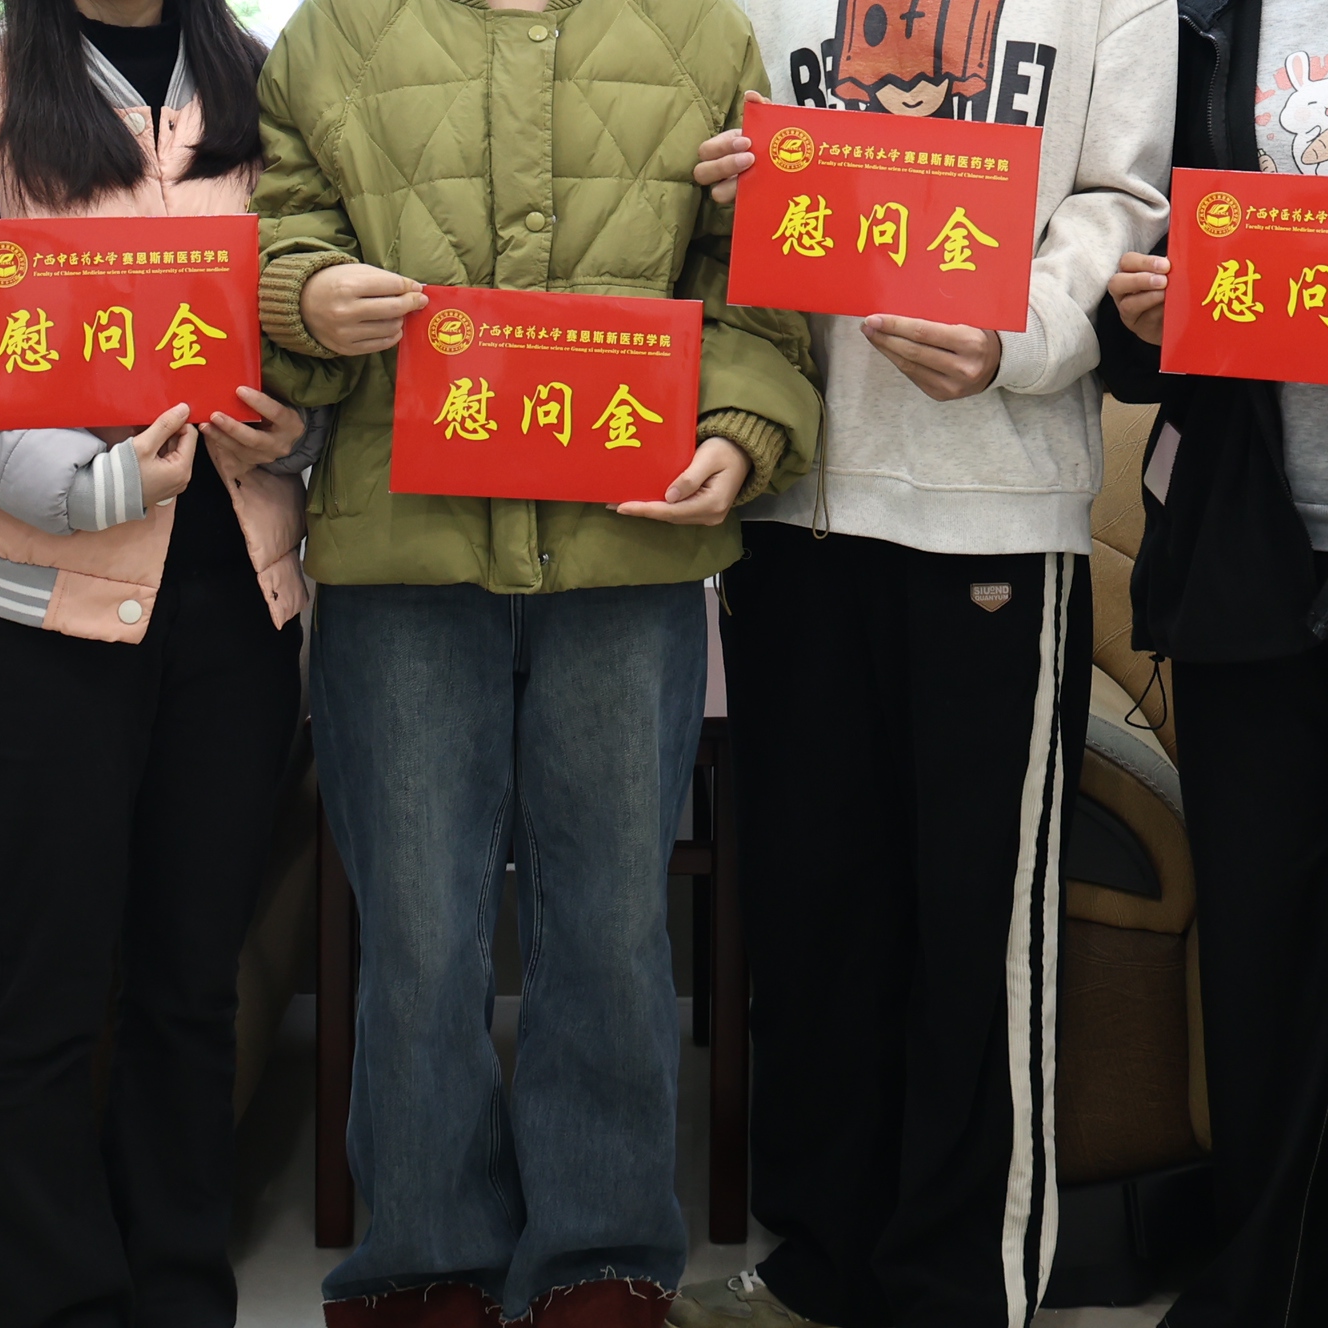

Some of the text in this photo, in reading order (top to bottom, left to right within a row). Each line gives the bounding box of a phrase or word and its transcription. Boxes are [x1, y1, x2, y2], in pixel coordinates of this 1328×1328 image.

[817, 140, 901, 162] 广西中医药大学
[903, 150, 1009, 172] 赛恩斯新医药学院
[1244, 204, 1328, 224] 广西中医药大学
[772, 194, 999, 271] 慰问金
[32, 249, 229, 268] 广西中医药大学 赛恩斯新医药学院
[478, 321, 563, 341] 广西中医药大学
[565, 328, 671, 347] 赛恩斯新医药学院
[435, 378, 664, 449] 慰问金
